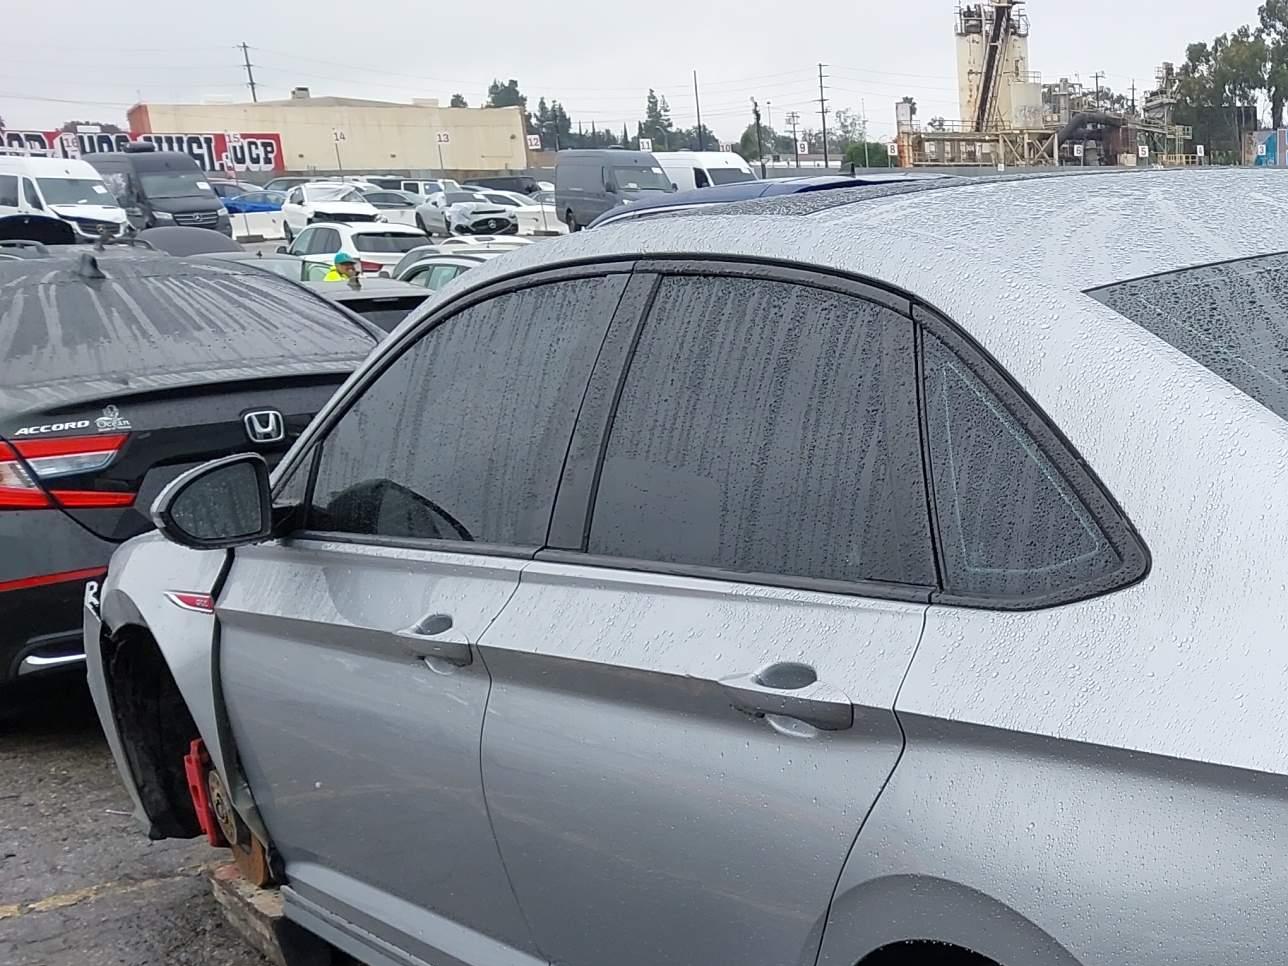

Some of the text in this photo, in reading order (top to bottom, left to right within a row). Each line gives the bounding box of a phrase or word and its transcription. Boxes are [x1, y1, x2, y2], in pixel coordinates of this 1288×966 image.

[227, 133, 241, 143] 15
[333, 132, 346, 142] 14
[437, 133, 450, 143] 13
[528, 137, 540, 147] 12
[641, 140, 651, 150] 11
[1140, 146, 1147, 156] 5
[14, 420, 90, 436] ACCORD
